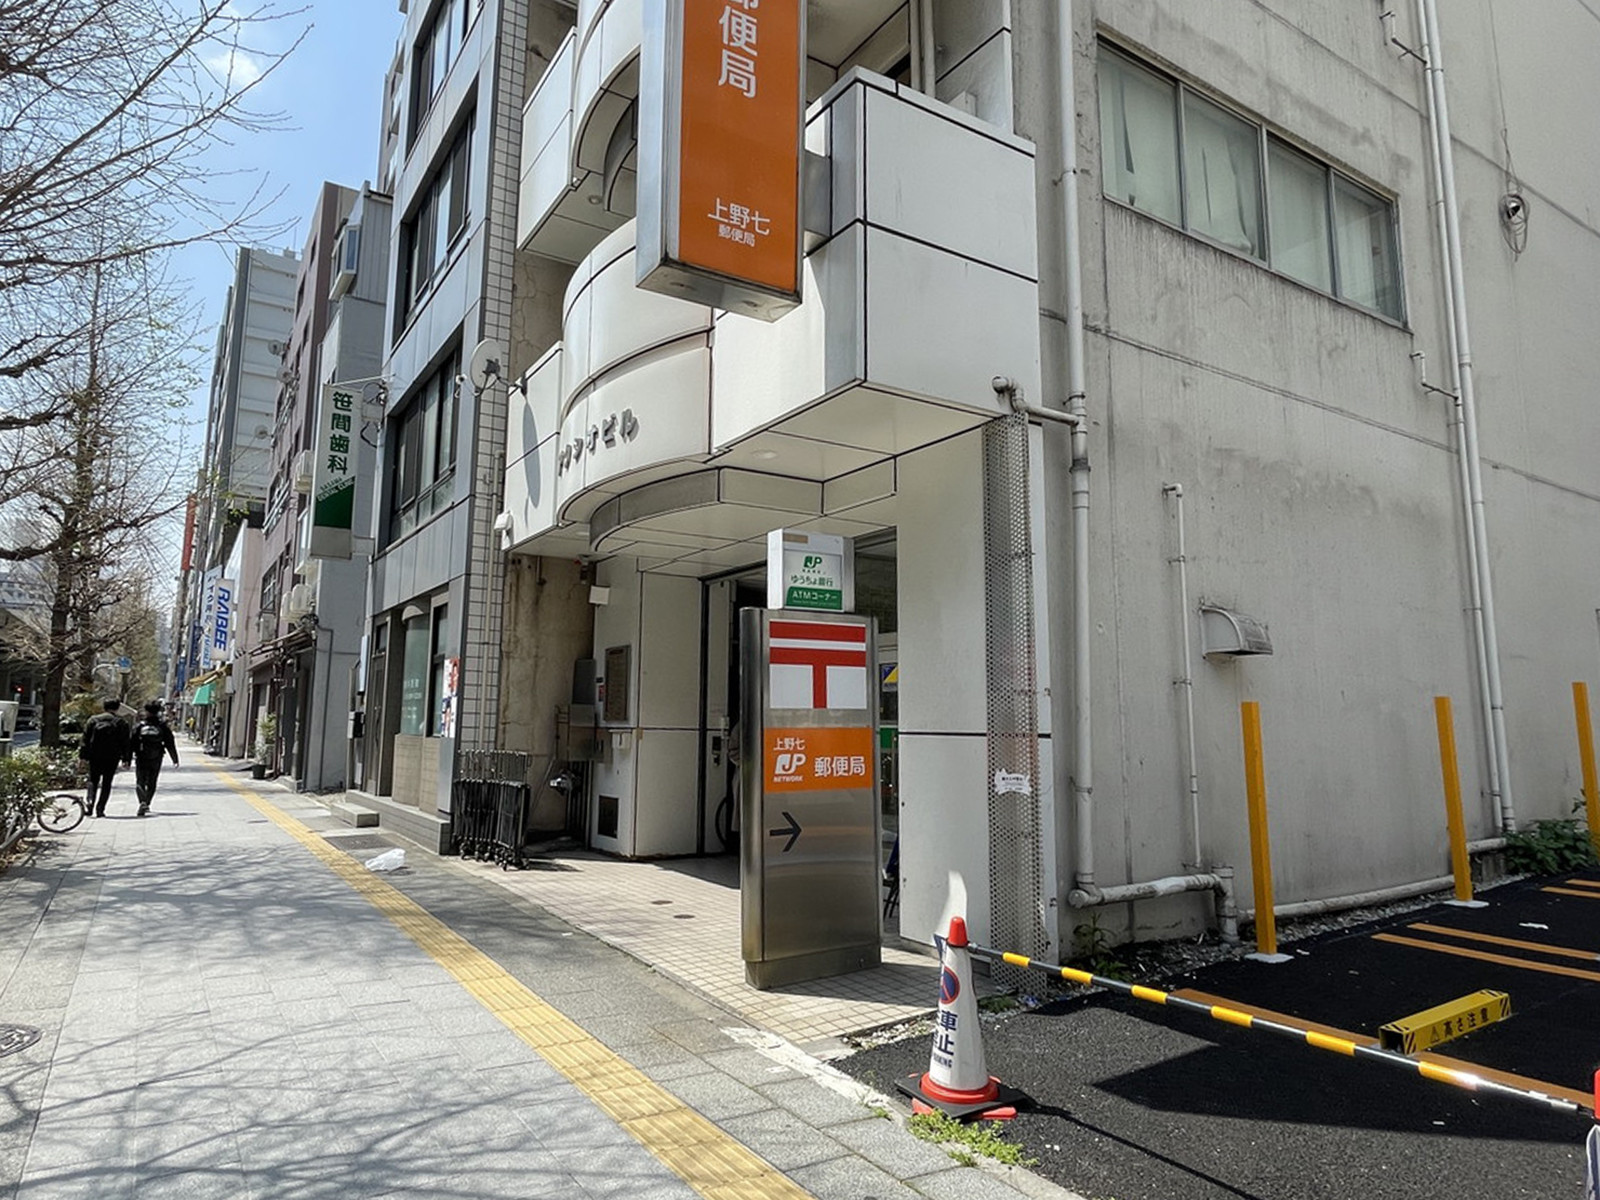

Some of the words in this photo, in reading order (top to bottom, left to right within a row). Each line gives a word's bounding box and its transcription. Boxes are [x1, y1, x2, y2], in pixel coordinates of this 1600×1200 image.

[707, 197, 771, 236] 上野七
[718, 224, 756, 247] 郵便局
[327, 391, 354, 476] 笹間歯科
[214, 586, 232, 652] RABEE
[773, 737, 806, 751] 上野七
[814, 756, 866, 777] 郵便局
[937, 1010, 958, 1031] 車
